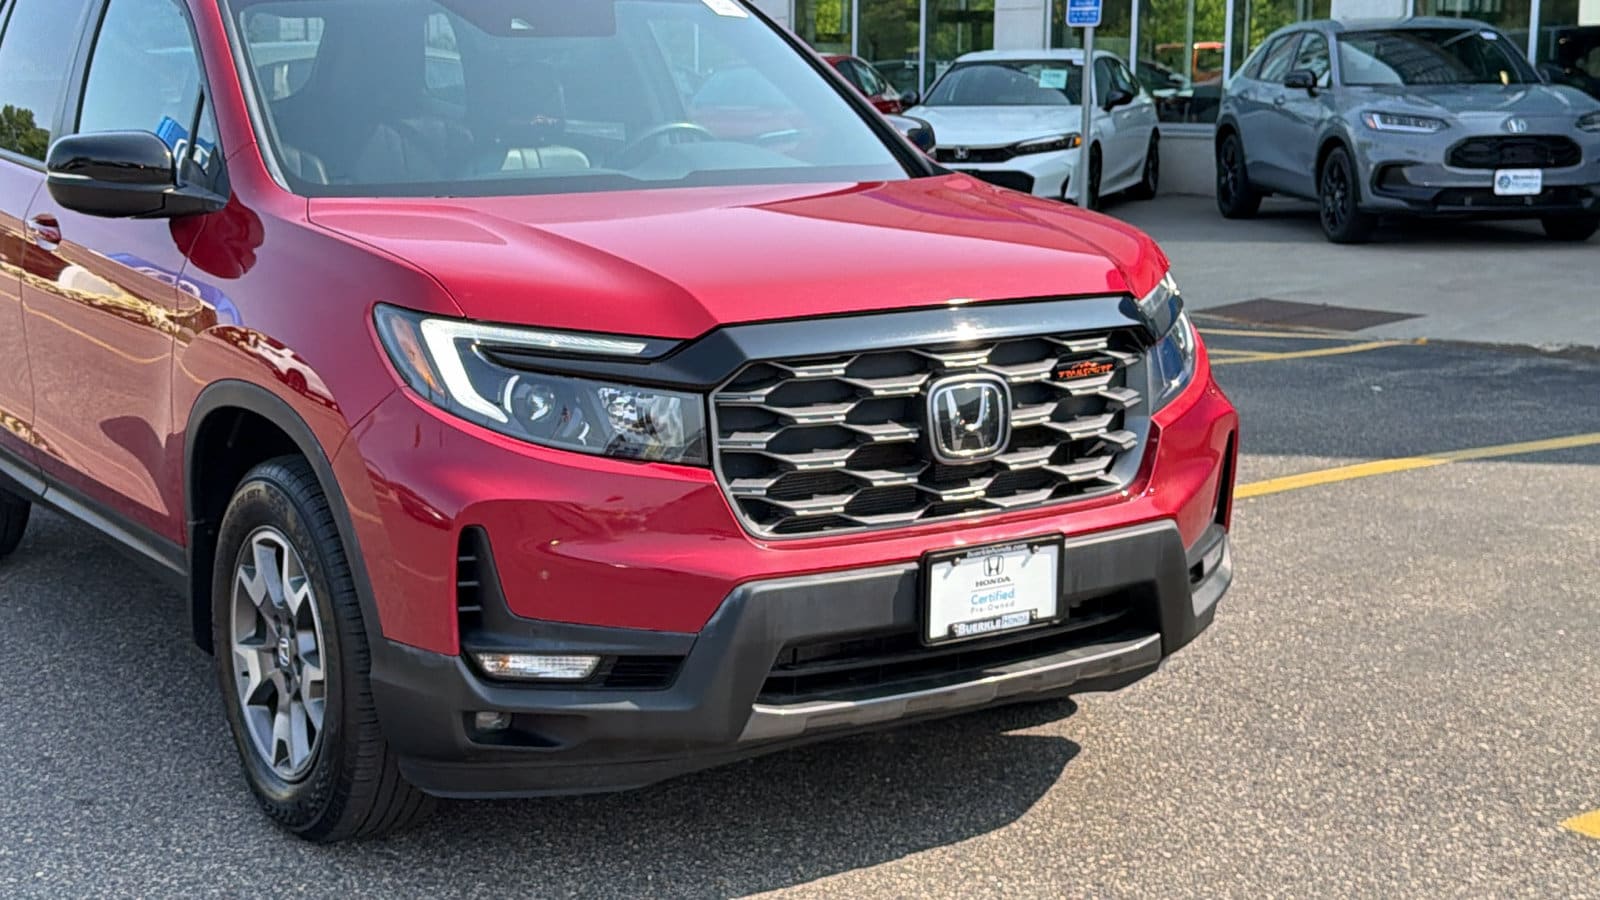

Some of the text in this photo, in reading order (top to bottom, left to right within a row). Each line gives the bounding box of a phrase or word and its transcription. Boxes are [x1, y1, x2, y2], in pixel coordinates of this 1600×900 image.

[975, 576, 1011, 587] HONDA
[971, 588, 1015, 605] Certified
[971, 601, 1015, 614] Pre-Owned
